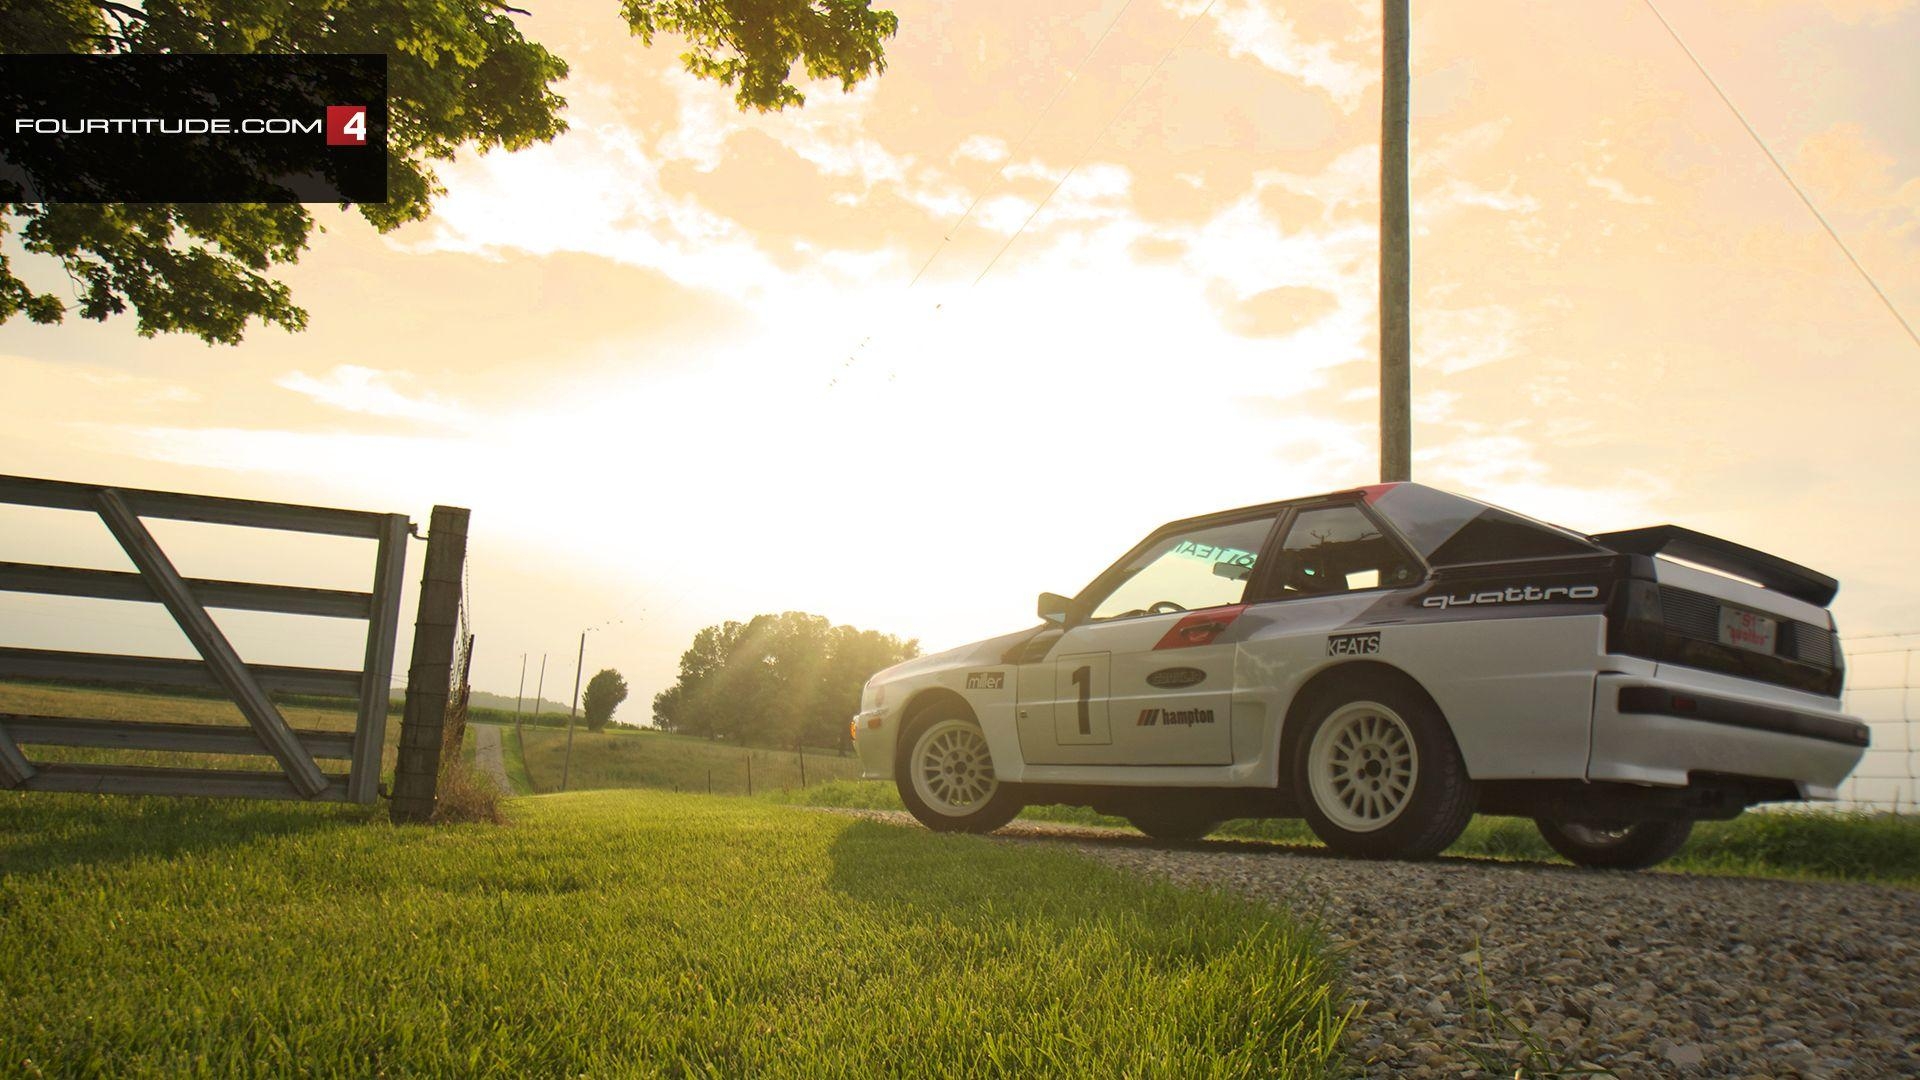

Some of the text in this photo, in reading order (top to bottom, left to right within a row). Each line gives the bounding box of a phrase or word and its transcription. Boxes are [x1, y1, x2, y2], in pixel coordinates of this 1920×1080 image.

[1422, 585, 1600, 609] quattro
[1328, 635, 1380, 656] KEATS
[967, 672, 1003, 689] miller
[1071, 665, 1091, 735] 1
[1162, 708, 1214, 727] hampton
